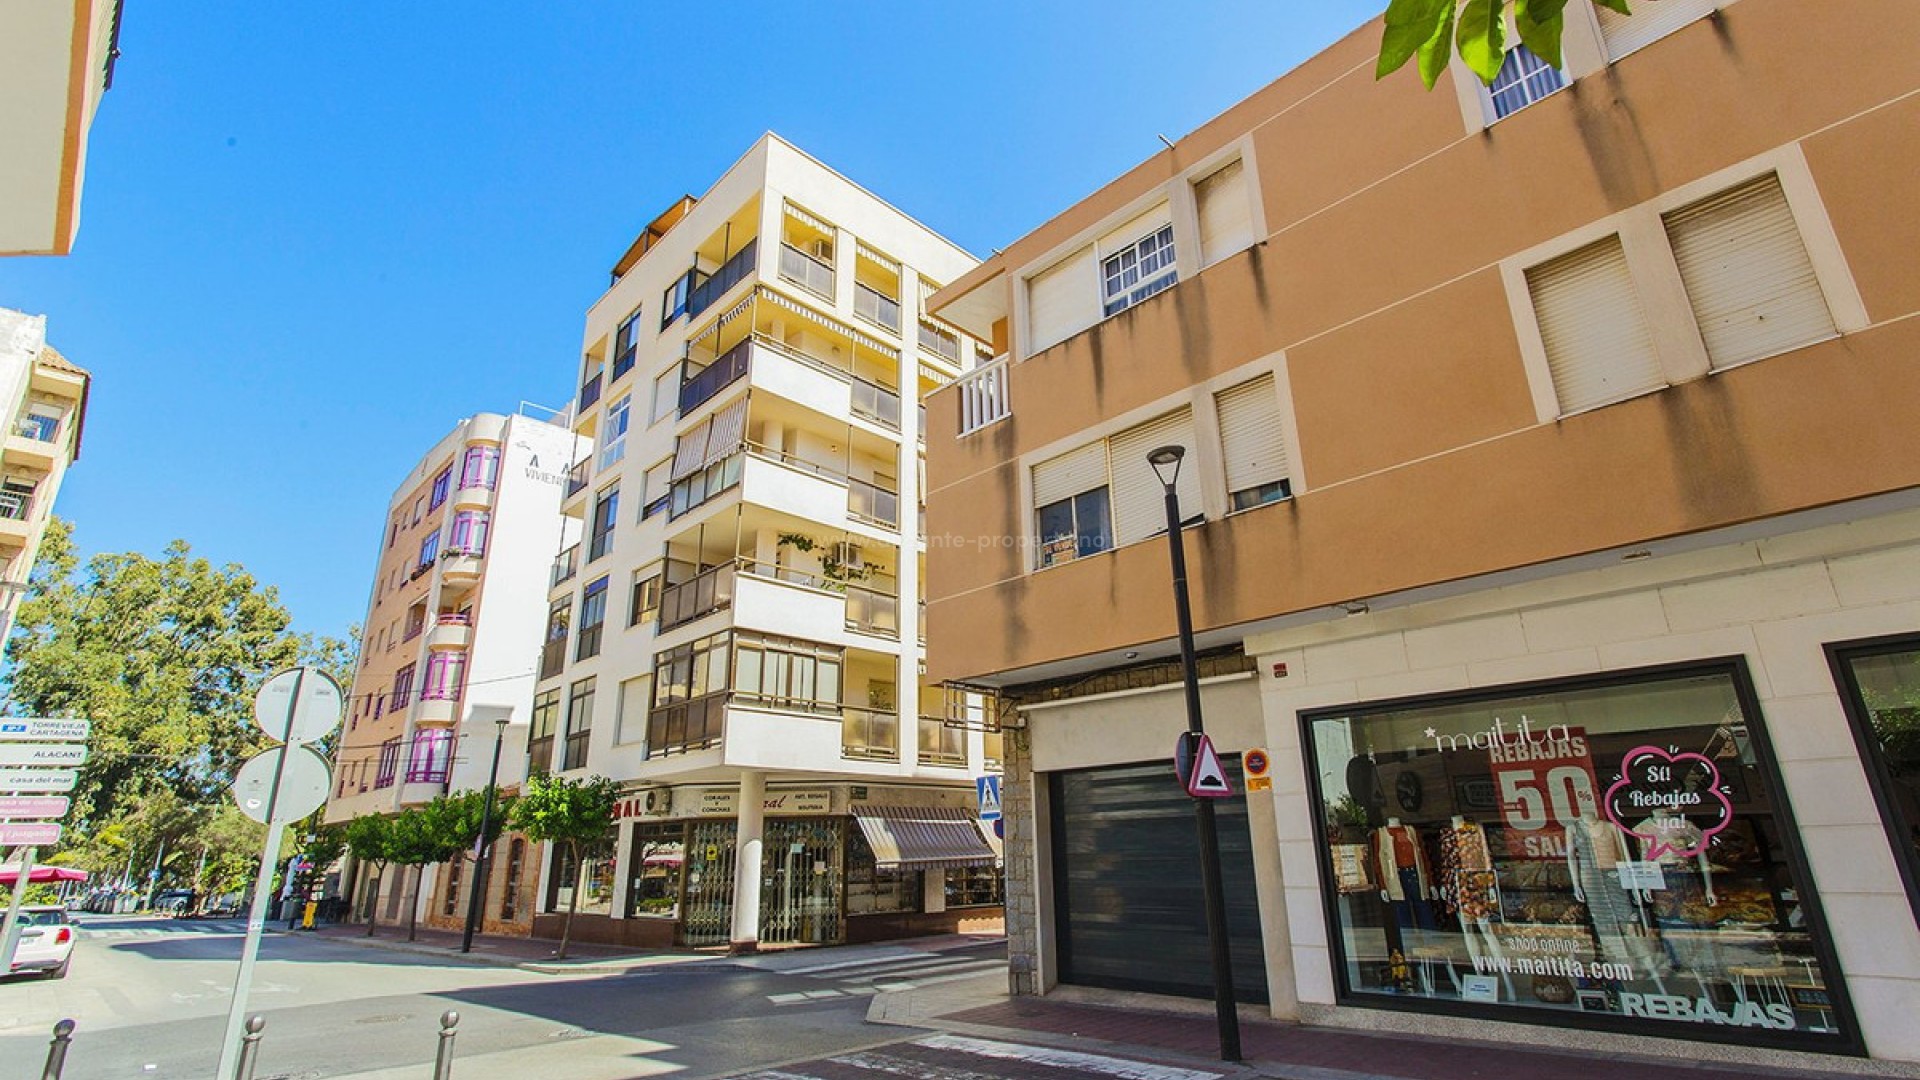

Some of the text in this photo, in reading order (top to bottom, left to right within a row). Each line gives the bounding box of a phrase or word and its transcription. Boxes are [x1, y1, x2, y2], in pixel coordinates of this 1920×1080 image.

[33, 722, 86, 730] TORREVIEJA
[1436, 715, 1570, 751] maitita
[33, 750, 83, 758] ALACANT
[1491, 736, 1587, 764] REBAJAS
[35, 776, 52, 784] del
[1629, 790, 1702, 809] Rebajas
[1656, 813, 1687, 834] ya!
[1524, 835, 1568, 858] SAL
[1508, 935, 1580, 954] shop online
[1470, 953, 1635, 982] www.maitita.com
[1620, 992, 1797, 1031] REBAJAS
